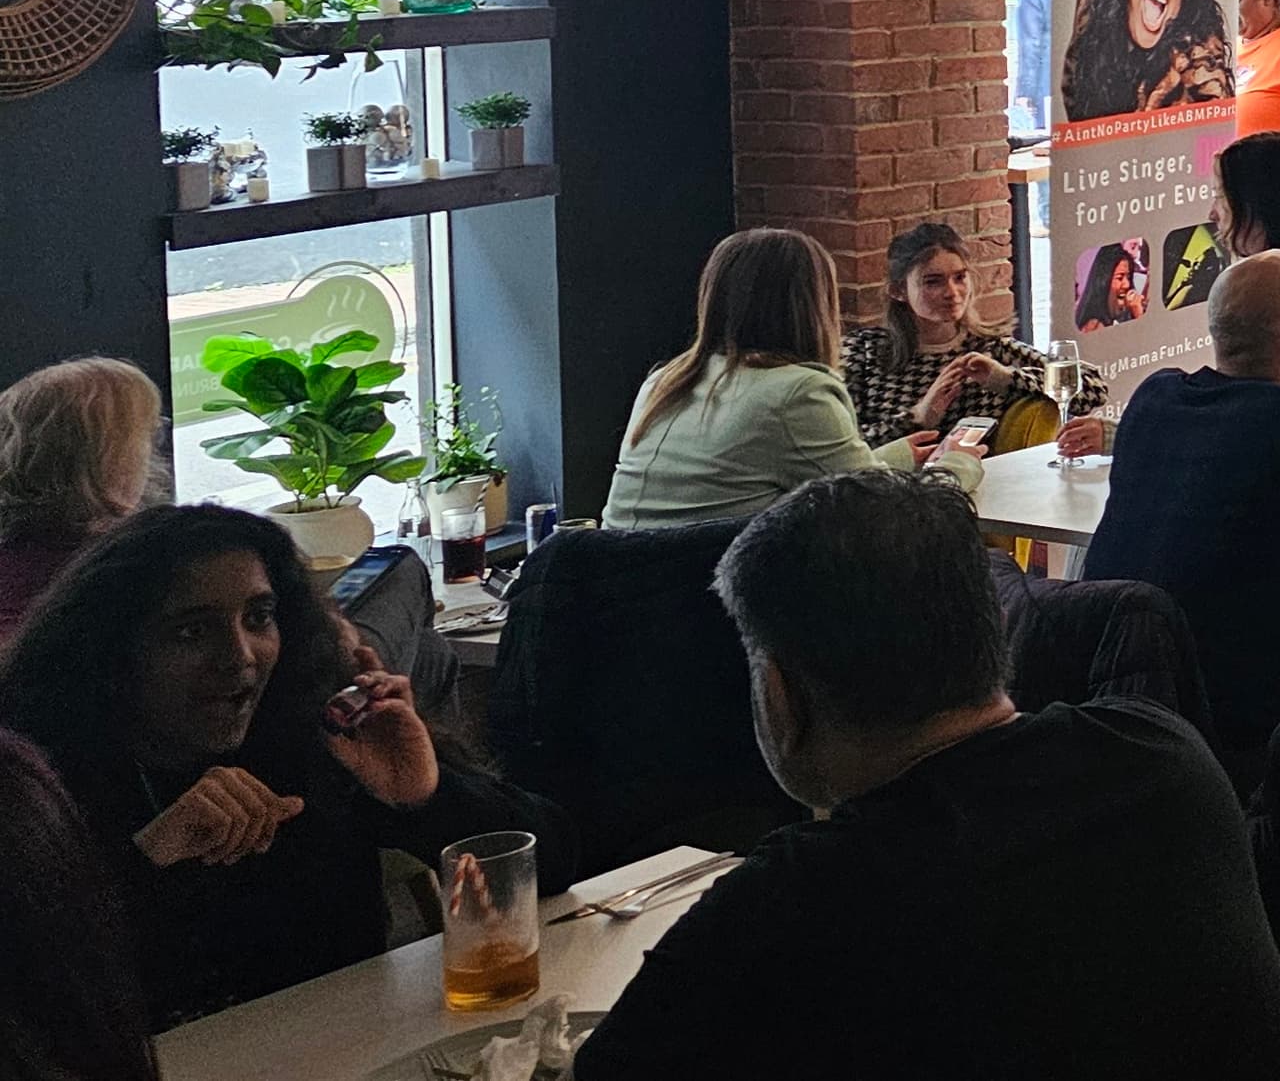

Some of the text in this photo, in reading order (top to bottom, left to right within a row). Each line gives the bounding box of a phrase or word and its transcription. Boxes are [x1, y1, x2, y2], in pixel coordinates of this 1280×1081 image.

[1063, 153, 1193, 194] Live Singer,
[1075, 202, 1106, 227] for
[1117, 193, 1166, 224] your
[1097, 334, 1213, 380] igMamaFunk.co
